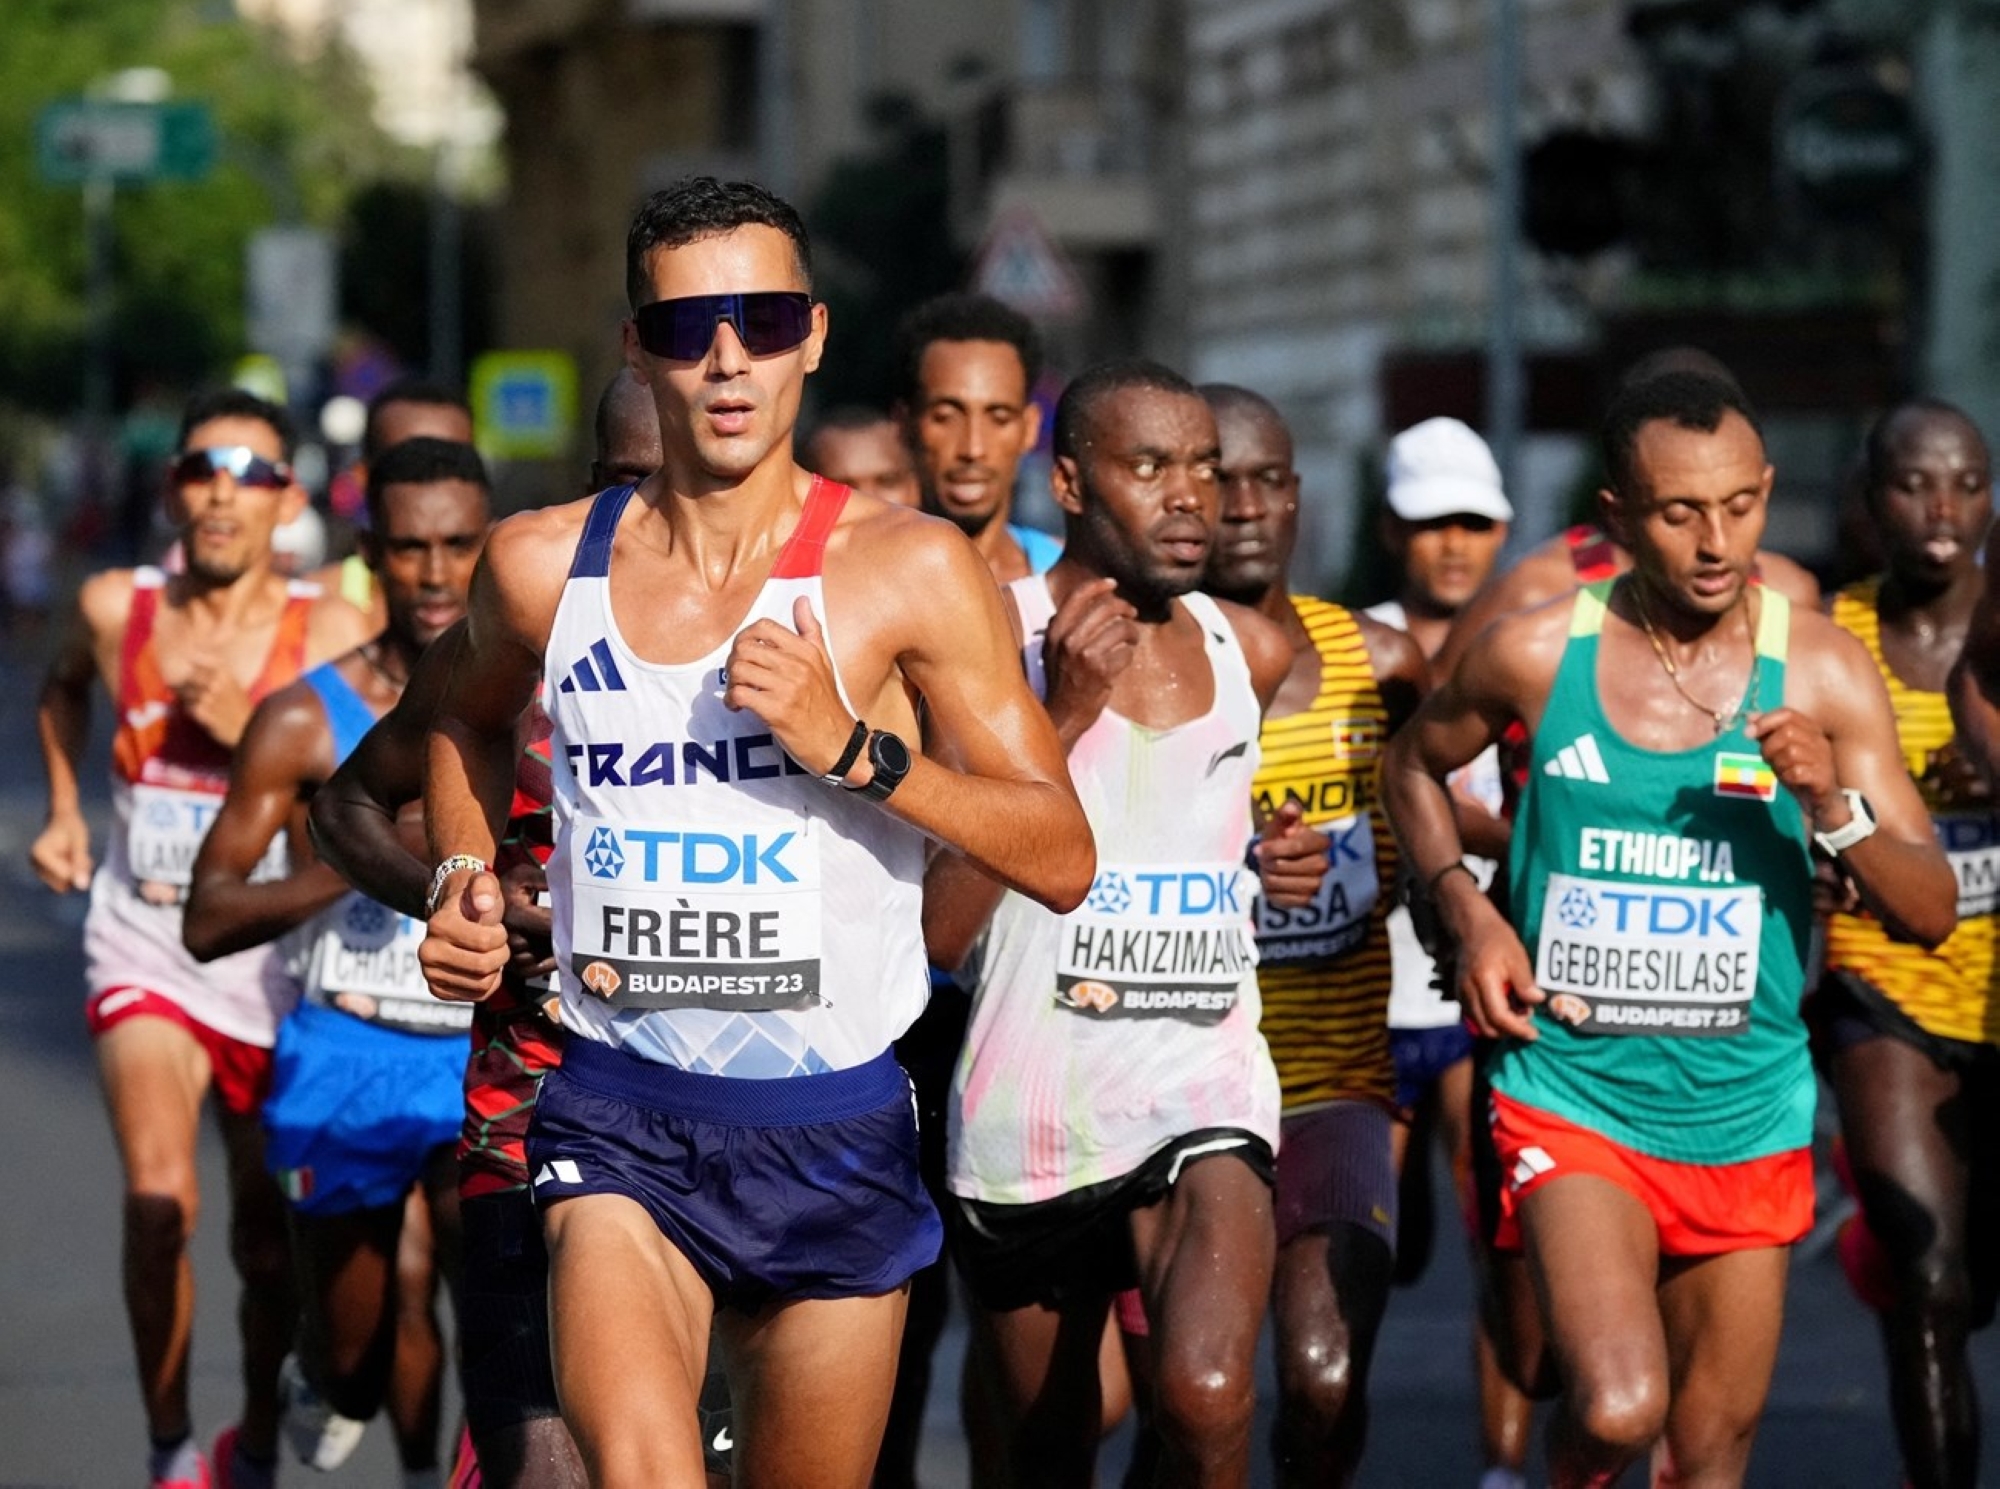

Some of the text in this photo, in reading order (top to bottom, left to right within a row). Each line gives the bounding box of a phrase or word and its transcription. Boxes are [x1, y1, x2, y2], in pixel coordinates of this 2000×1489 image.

[625, 830, 799, 884] TDK
[1579, 827, 1735, 883] ETHIOPIA
[1135, 871, 1240, 915] TDK
[1252, 881, 1349, 931] ISSA
[1600, 891, 1742, 936] TDK
[602, 898, 780, 959] FRÈRE
[1071, 925, 1251, 974] HAKIZIMANA
[335, 943, 424, 991] CHIAP
[628, 973, 804, 995] BUDAPEST 23
[1547, 939, 1748, 994] GEBRESILASE
[1122, 990, 1234, 1011] BUDAPEST
[1596, 1004, 1741, 1028] BUDAPEST 23
